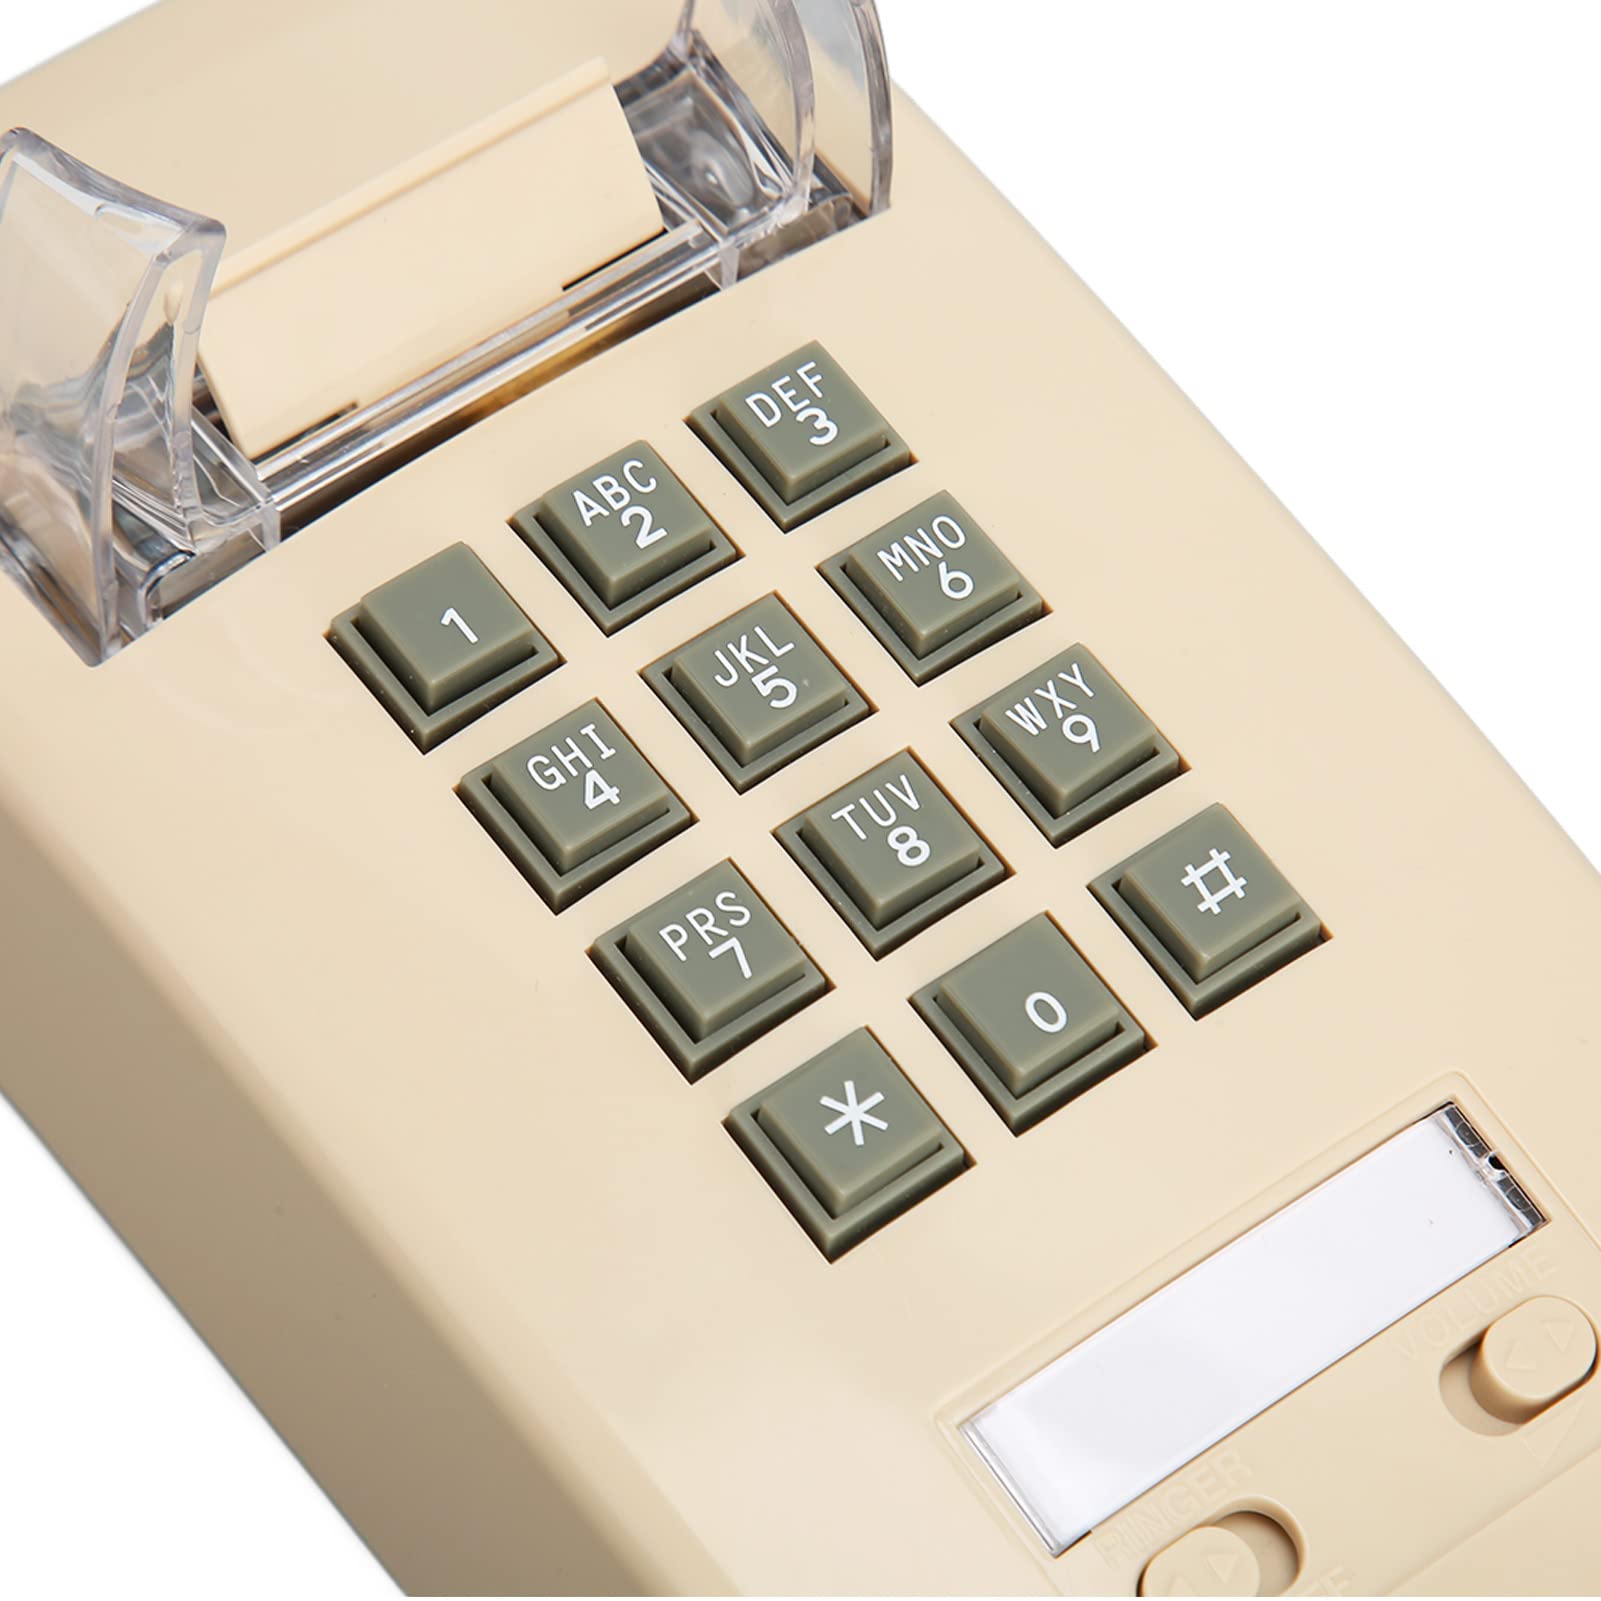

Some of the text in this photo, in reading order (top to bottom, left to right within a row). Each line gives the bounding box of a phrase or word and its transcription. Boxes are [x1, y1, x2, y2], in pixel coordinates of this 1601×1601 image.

[744, 361, 823, 428] DEF
[795, 407, 838, 445] 3
[572, 460, 657, 527] ABC
[620, 505, 668, 549] 2
[876, 515, 966, 582] MNO
[938, 561, 974, 599] 6
[440, 607, 479, 644] 1
[714, 625, 795, 687] JKL
[751, 664, 798, 708] 5
[1004, 662, 1095, 736] WXY
[527, 723, 616, 790] GHI
[1061, 714, 1100, 753] 9
[584, 769, 621, 810] 4
[831, 774, 920, 840] TUV
[887, 825, 931, 867] 8
[1180, 848, 1247, 915] #
[658, 891, 751, 962] PRS
[708, 936, 753, 979] 7
[1394, 1248, 1558, 1360] VOLUME
[1094, 1450, 1252, 1568] RINGER
